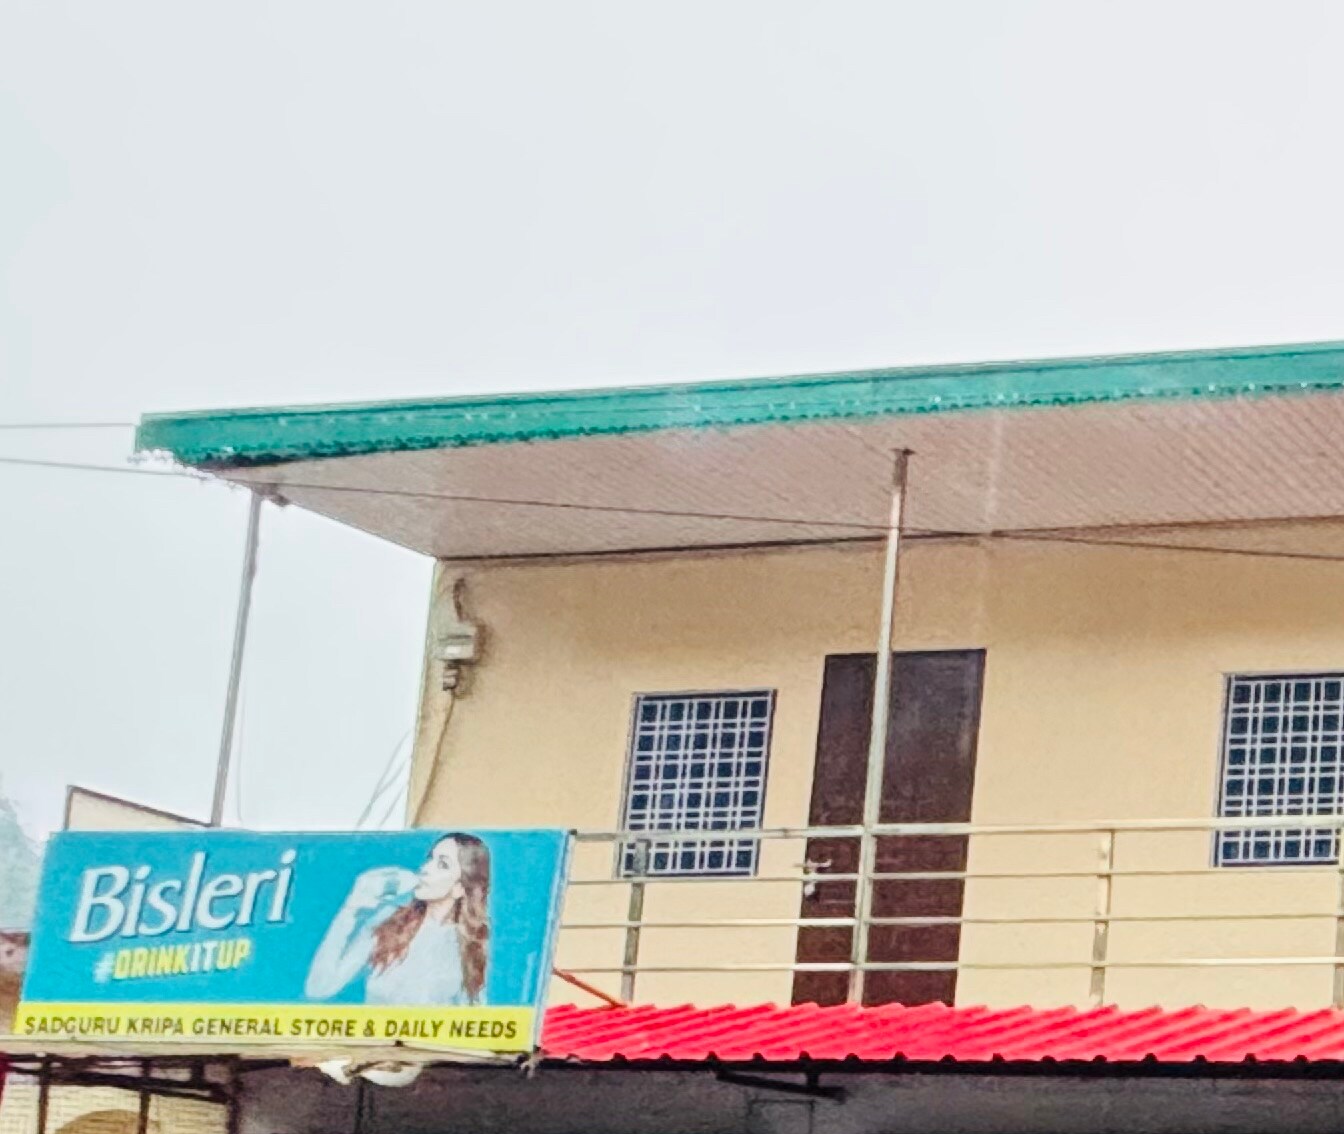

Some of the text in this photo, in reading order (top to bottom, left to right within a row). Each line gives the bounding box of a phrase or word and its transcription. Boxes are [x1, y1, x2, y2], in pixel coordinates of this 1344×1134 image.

[68, 849, 296, 942] Bisleri
[24, 1016, 518, 1039] SADGURU KRIPA GENERAL STORE & DAILY NEEDS
